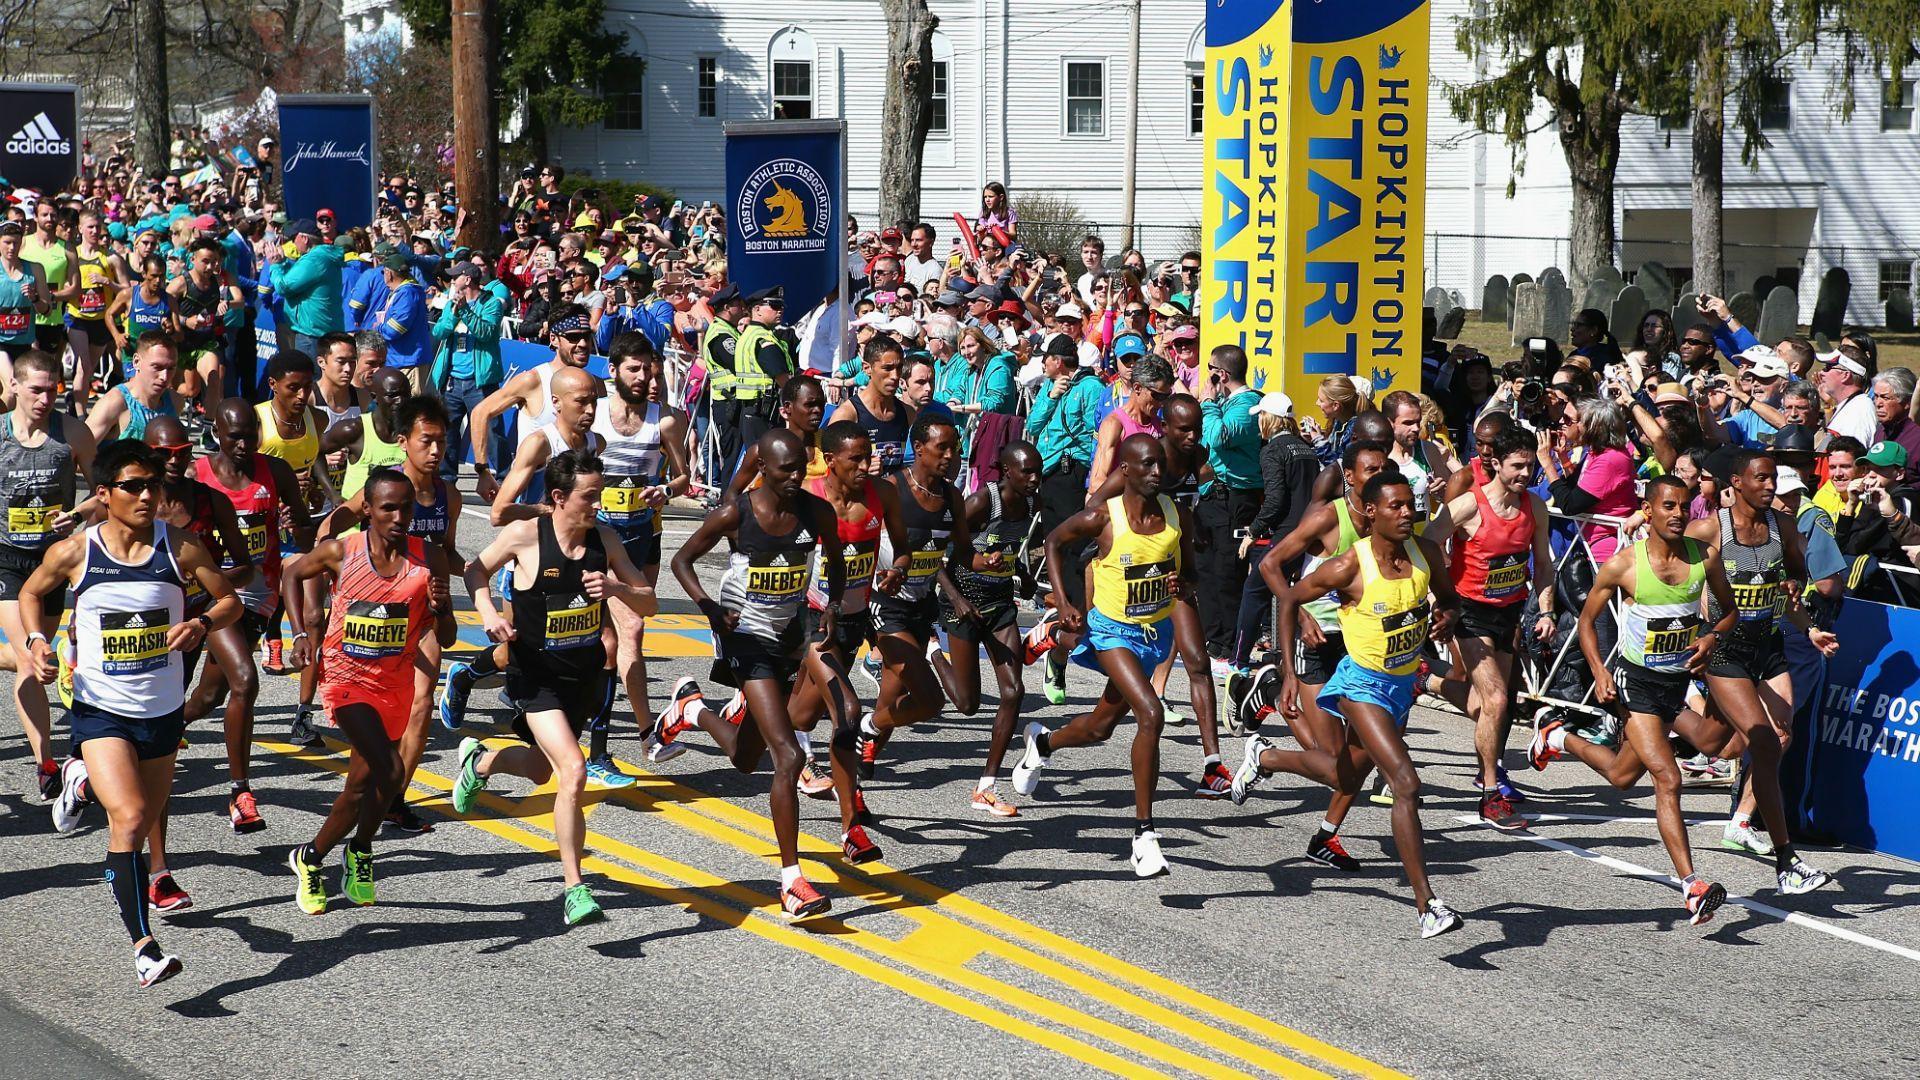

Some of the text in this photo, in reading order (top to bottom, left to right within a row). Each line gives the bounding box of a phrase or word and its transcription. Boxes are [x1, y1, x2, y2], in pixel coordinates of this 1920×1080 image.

[5, 138, 70, 154] adidas
[283, 139, 370, 173] John Hancock
[475, 148, 485, 159] 2
[741, 162, 829, 233] BOSTON ATHLETIC ASSOCIATION
[1254, 77, 1278, 357] HOPKINTON
[1303, 55, 1364, 376] START
[1371, 78, 1410, 357] HOPKINTON
[745, 238, 826, 251] BOSTON MARATHON
[81, 293, 101, 305] 753
[4, 316, 26, 326] 124
[8, 468, 58, 478] FLEET FEET
[616, 491, 635, 505] 31
[26, 511, 48, 526] 37
[88, 566, 106, 574] JOSAI
[750, 569, 807, 592] CHEBET
[1486, 568, 1526, 586] MERCIE
[1127, 577, 1168, 605] KORI
[344, 621, 407, 642] NAGEEYE
[548, 608, 600, 634] BURRELL
[1652, 630, 1692, 654] ROBI
[1825, 683, 1870, 716] THE
